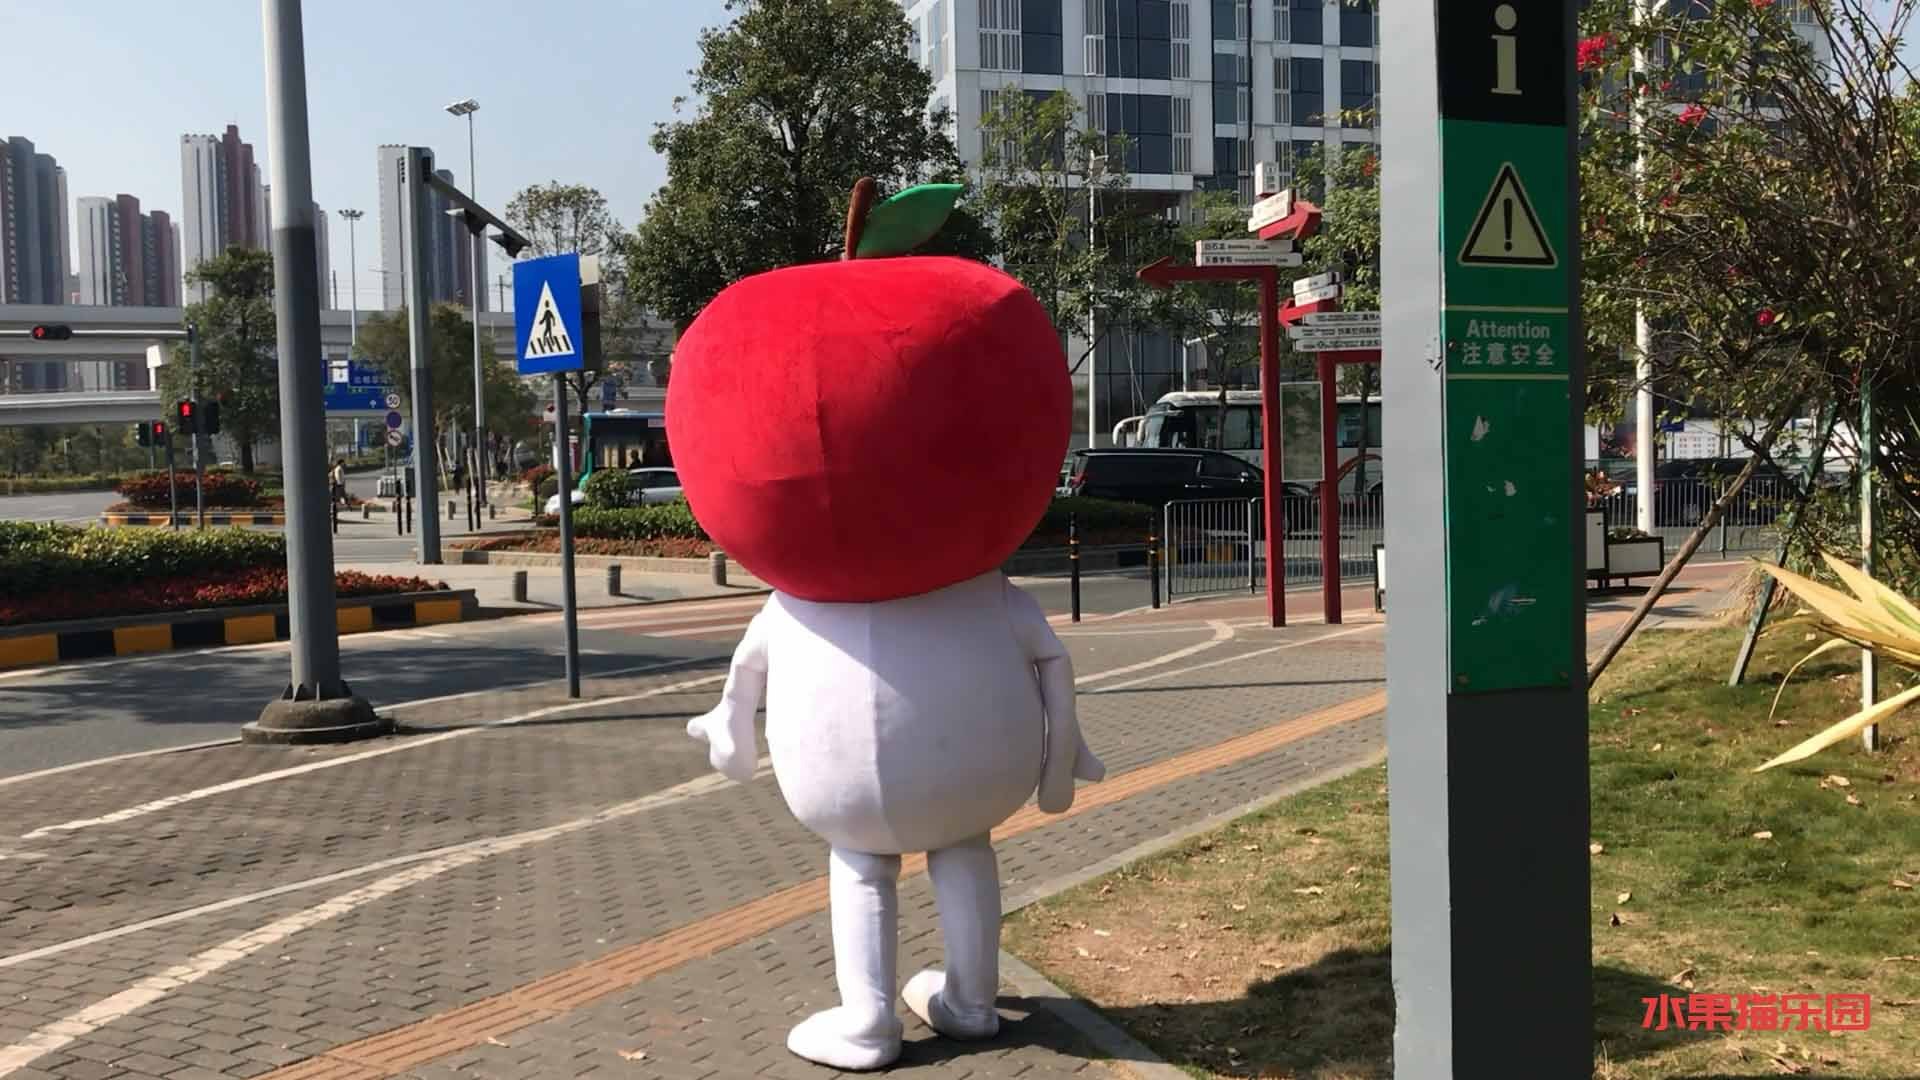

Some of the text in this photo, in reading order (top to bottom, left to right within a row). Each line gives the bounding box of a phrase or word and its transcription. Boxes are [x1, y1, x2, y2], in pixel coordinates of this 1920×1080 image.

[1466, 320, 1551, 338] Attention
[1462, 342, 1554, 365] 注意安全
